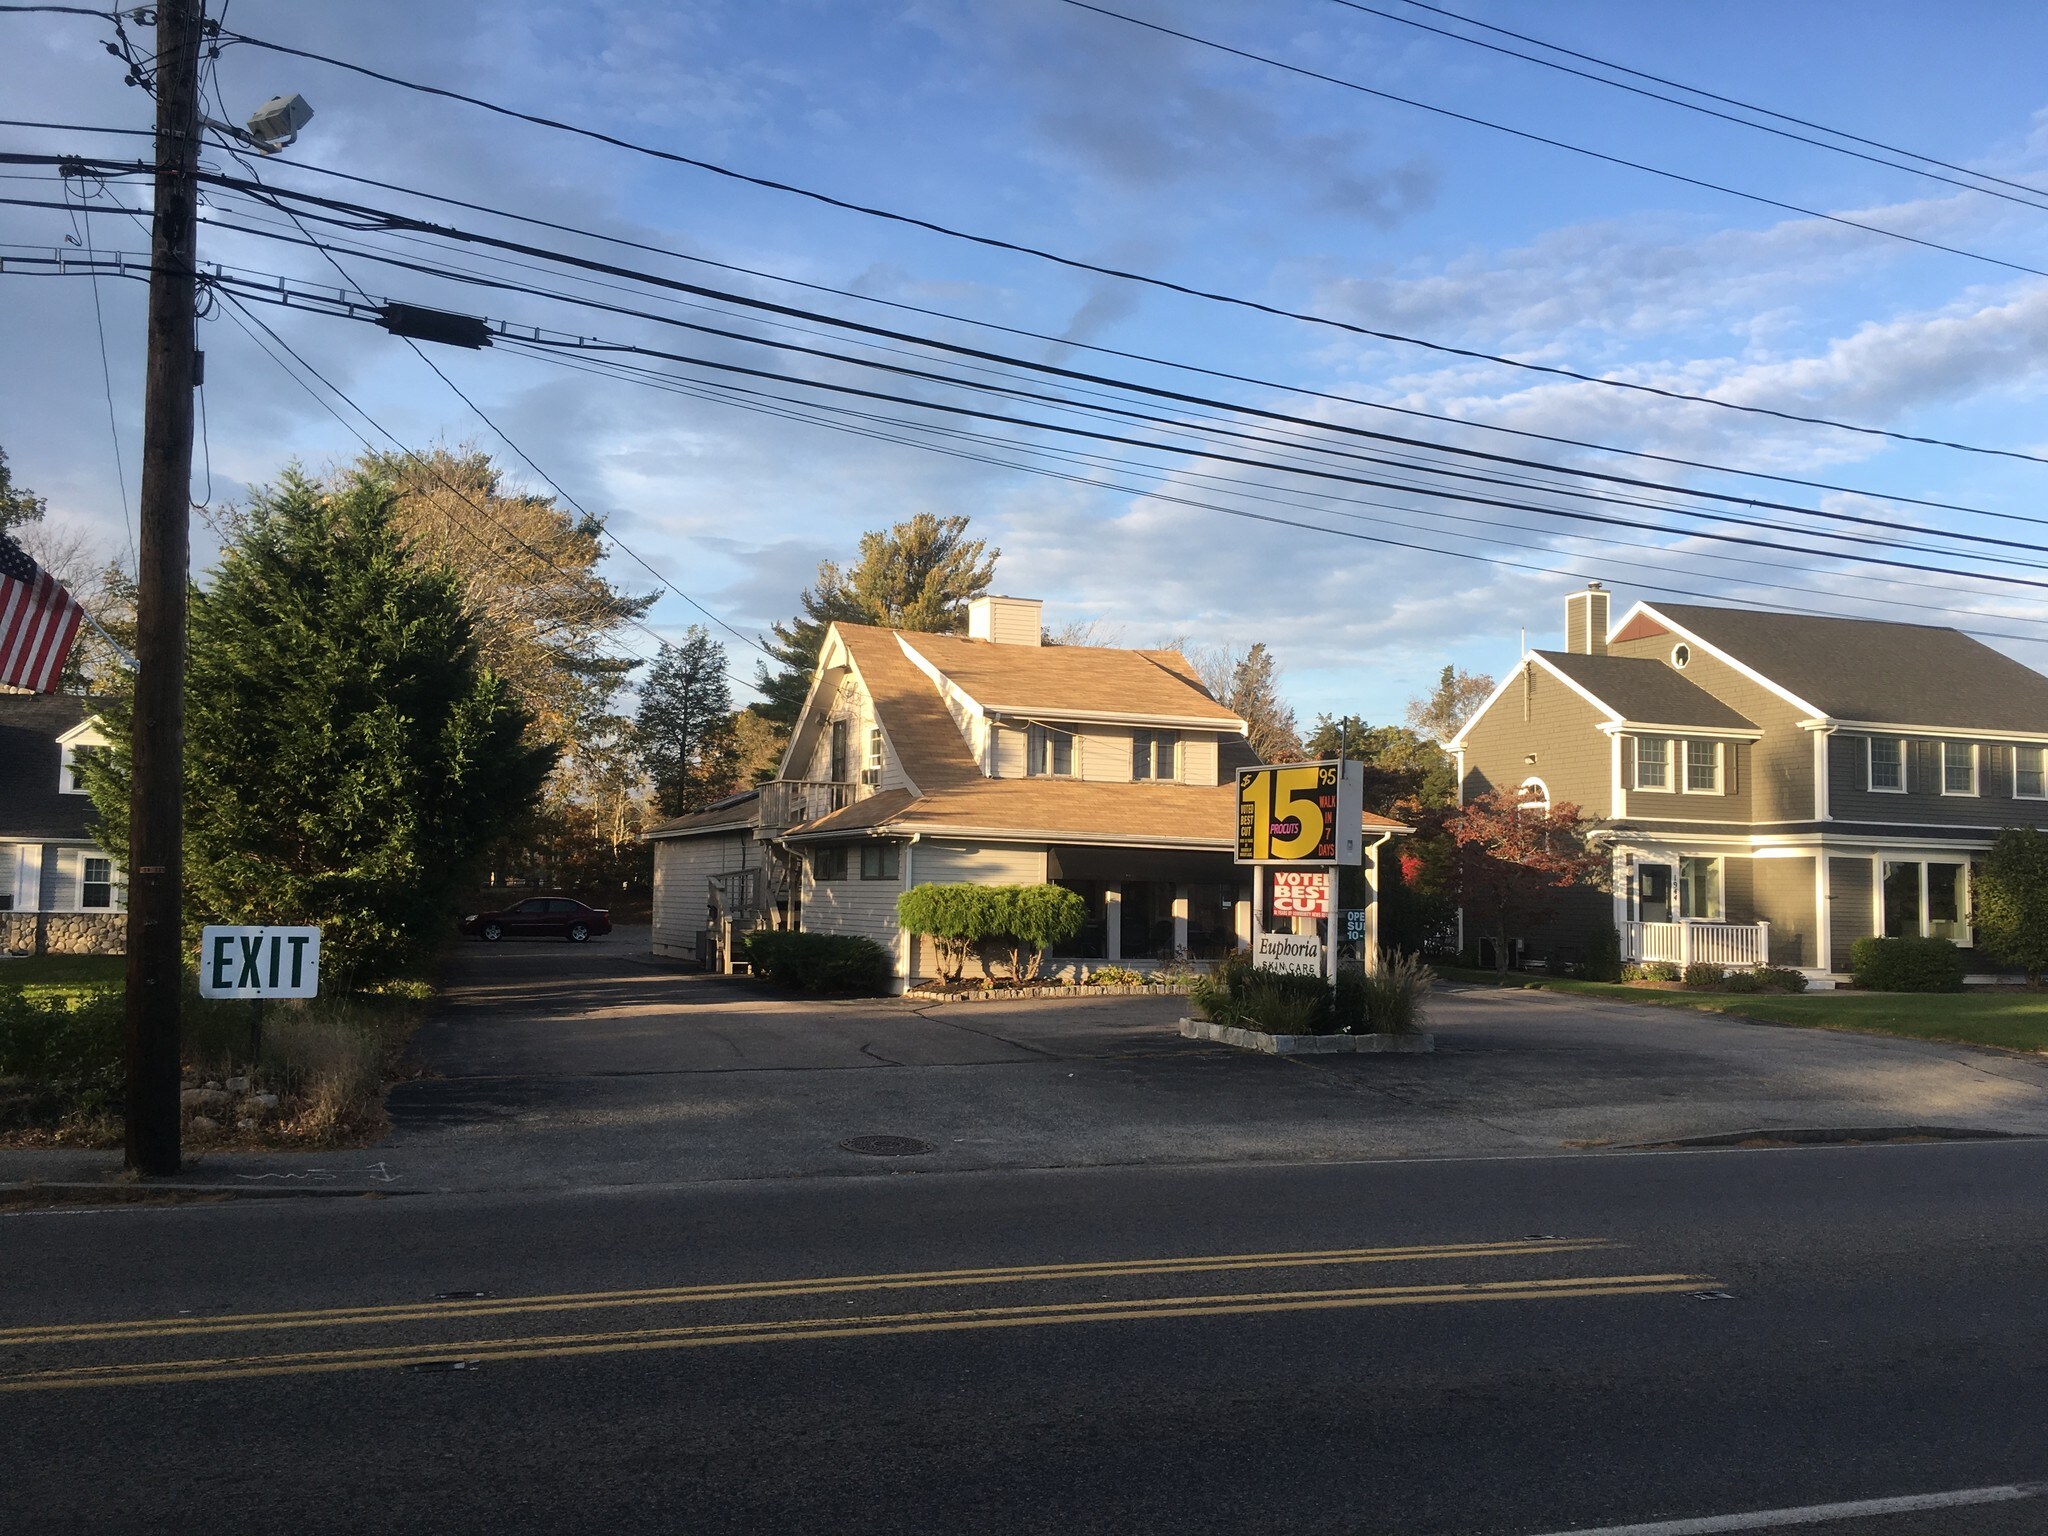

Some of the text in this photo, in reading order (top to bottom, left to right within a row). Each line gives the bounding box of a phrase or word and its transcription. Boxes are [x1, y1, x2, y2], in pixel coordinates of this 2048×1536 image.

[1319, 768, 1336, 785] 95
[1319, 795, 1336, 808] WALK
[1240, 815, 1254, 825] BEST
[1324, 811, 1332, 824] IN
[1241, 826, 1251, 837] CUT
[1269, 823, 1299, 835] PROCUTS
[1325, 827, 1331, 840] 7
[1318, 844, 1335, 857] DAYS
[1274, 886, 1330, 899] BEST
[1274, 898, 1329, 912] CUT
[1347, 911, 1365, 921] OPE
[1347, 930, 1365, 940] 10-
[1259, 938, 1317, 960] Euphoria
[212, 936, 309, 988] EXIT
[1262, 960, 1315, 973] SKIN CARE
